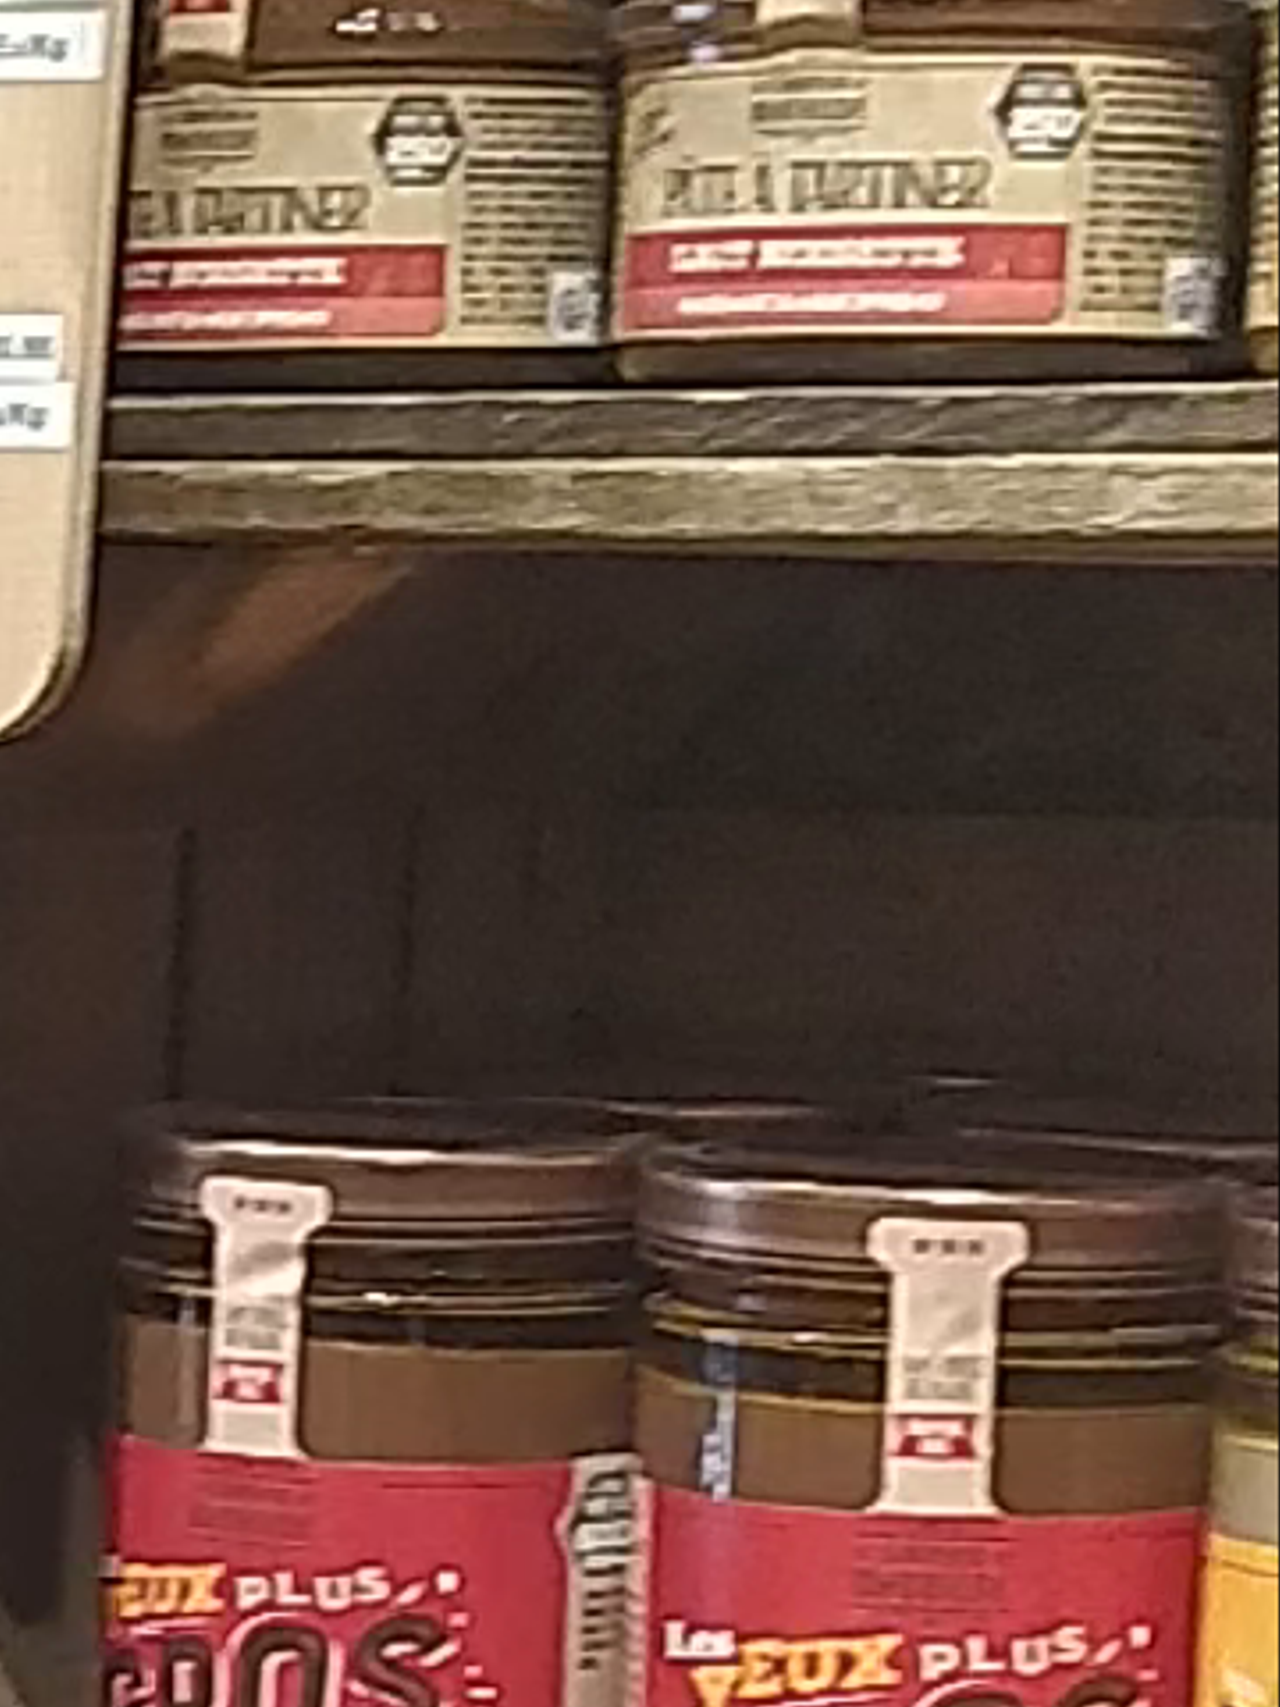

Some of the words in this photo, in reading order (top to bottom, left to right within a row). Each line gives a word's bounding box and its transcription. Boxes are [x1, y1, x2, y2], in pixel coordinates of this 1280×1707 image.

[108, 1563, 226, 1617] EUX
[234, 1566, 391, 1610] PLUS
[919, 1628, 1090, 1681] PLUS
